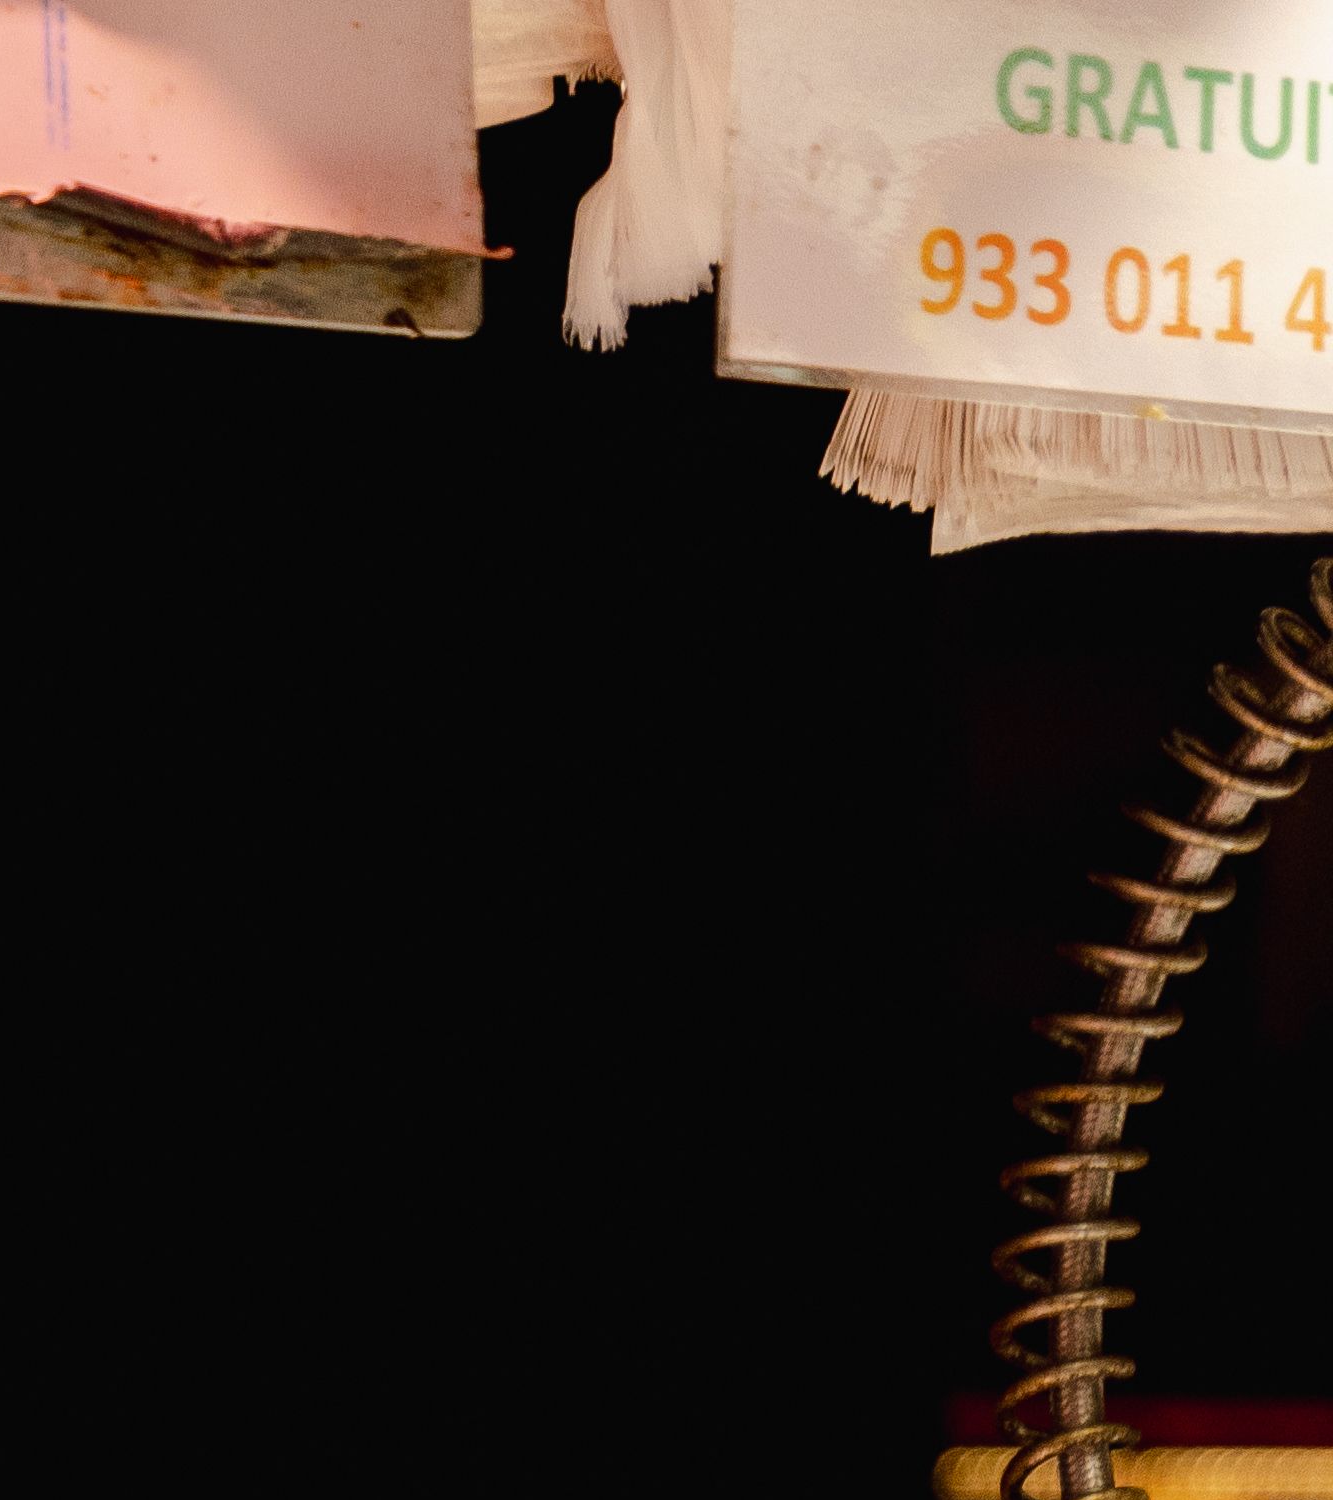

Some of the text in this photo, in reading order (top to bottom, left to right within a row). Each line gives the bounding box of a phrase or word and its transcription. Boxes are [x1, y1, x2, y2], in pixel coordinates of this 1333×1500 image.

[995, 47, 1333, 165] GRATUI
[919, 227, 1072, 326] 933
[1103, 246, 1255, 346] 011
